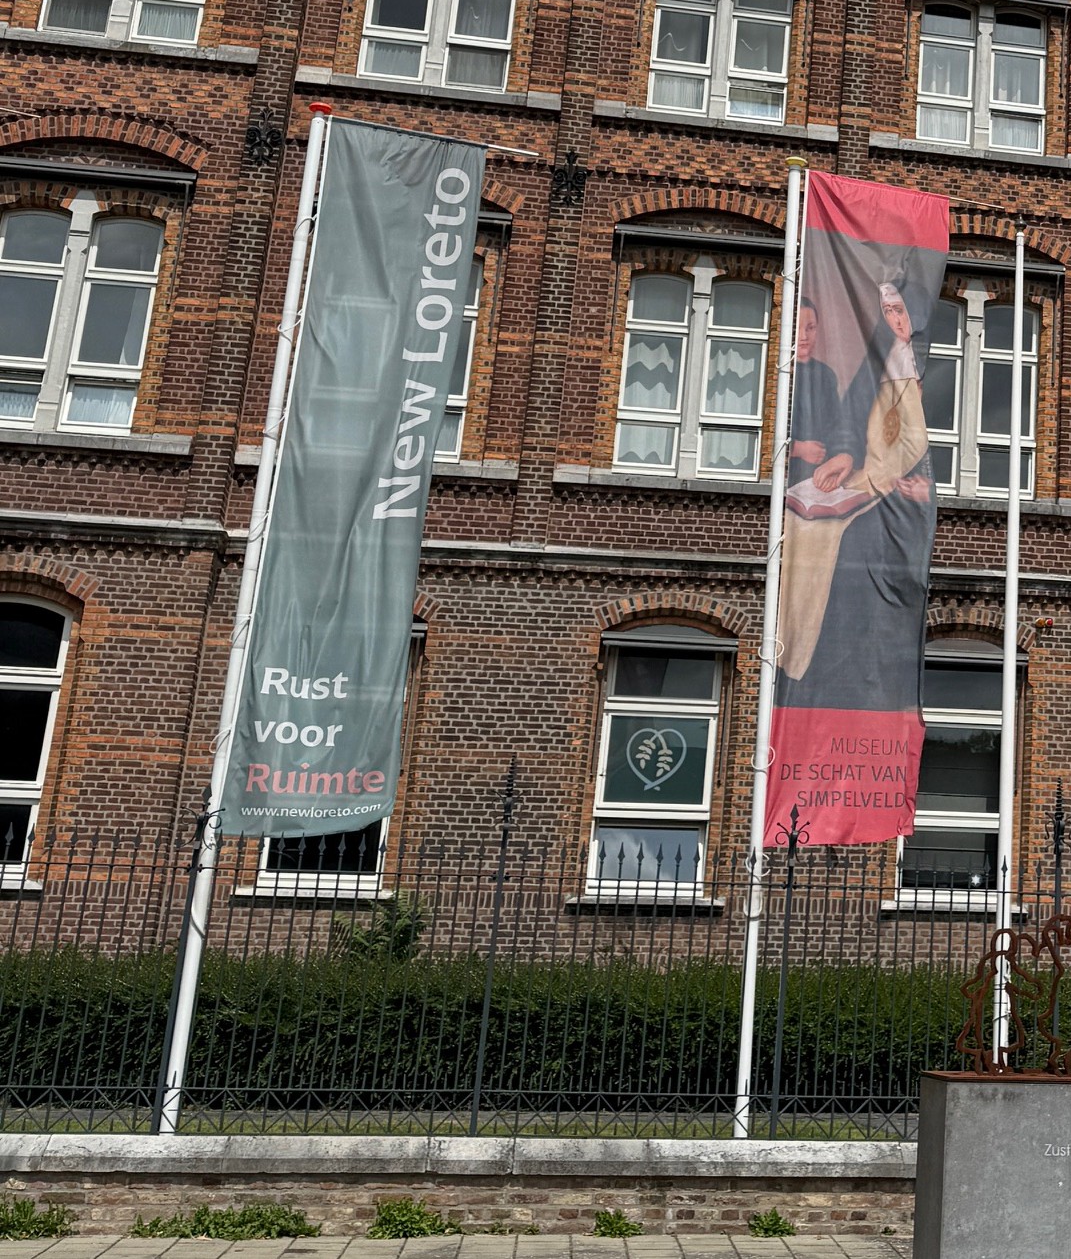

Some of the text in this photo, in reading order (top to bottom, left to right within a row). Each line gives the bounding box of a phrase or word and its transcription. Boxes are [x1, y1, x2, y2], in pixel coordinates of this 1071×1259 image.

[372, 167, 470, 520] New Loreto
[260, 667, 349, 700] Rust
[254, 720, 343, 747] voor
[830, 737, 909, 756] MUSEUM
[245, 762, 386, 795] Ruimte
[780, 763, 907, 782] DE SCHAT VAN
[241, 803, 381, 818] www.newloreto.com
[797, 790, 905, 808] SIMPELVELD
